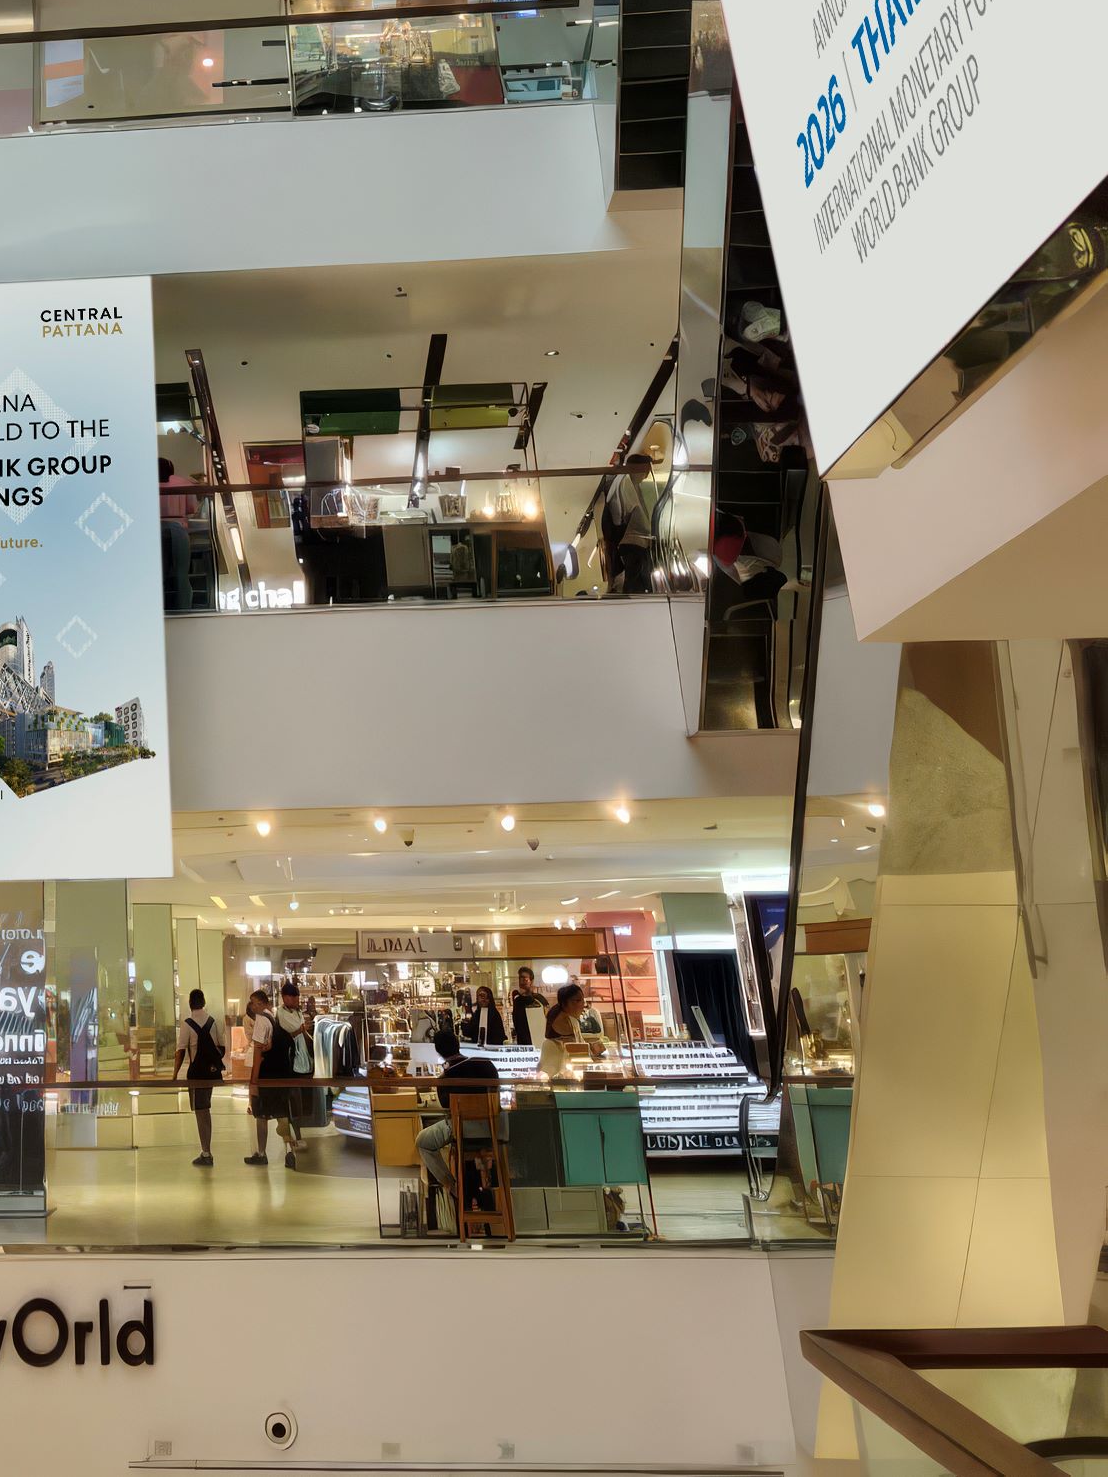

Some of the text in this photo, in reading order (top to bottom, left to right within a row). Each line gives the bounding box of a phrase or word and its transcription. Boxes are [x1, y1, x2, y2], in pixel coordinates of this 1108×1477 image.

[796, 74, 846, 189] 2026
[851, 55, 980, 263] WORLD BANK GROUP
[813, 110, 895, 254] INTERNATIONAL
[40, 306, 122, 322] CENTRAL
[42, 321, 122, 337] PATTANA
[28, 420, 59, 439] TO
[66, 418, 109, 438] THE
[27, 454, 111, 476] GROUP
